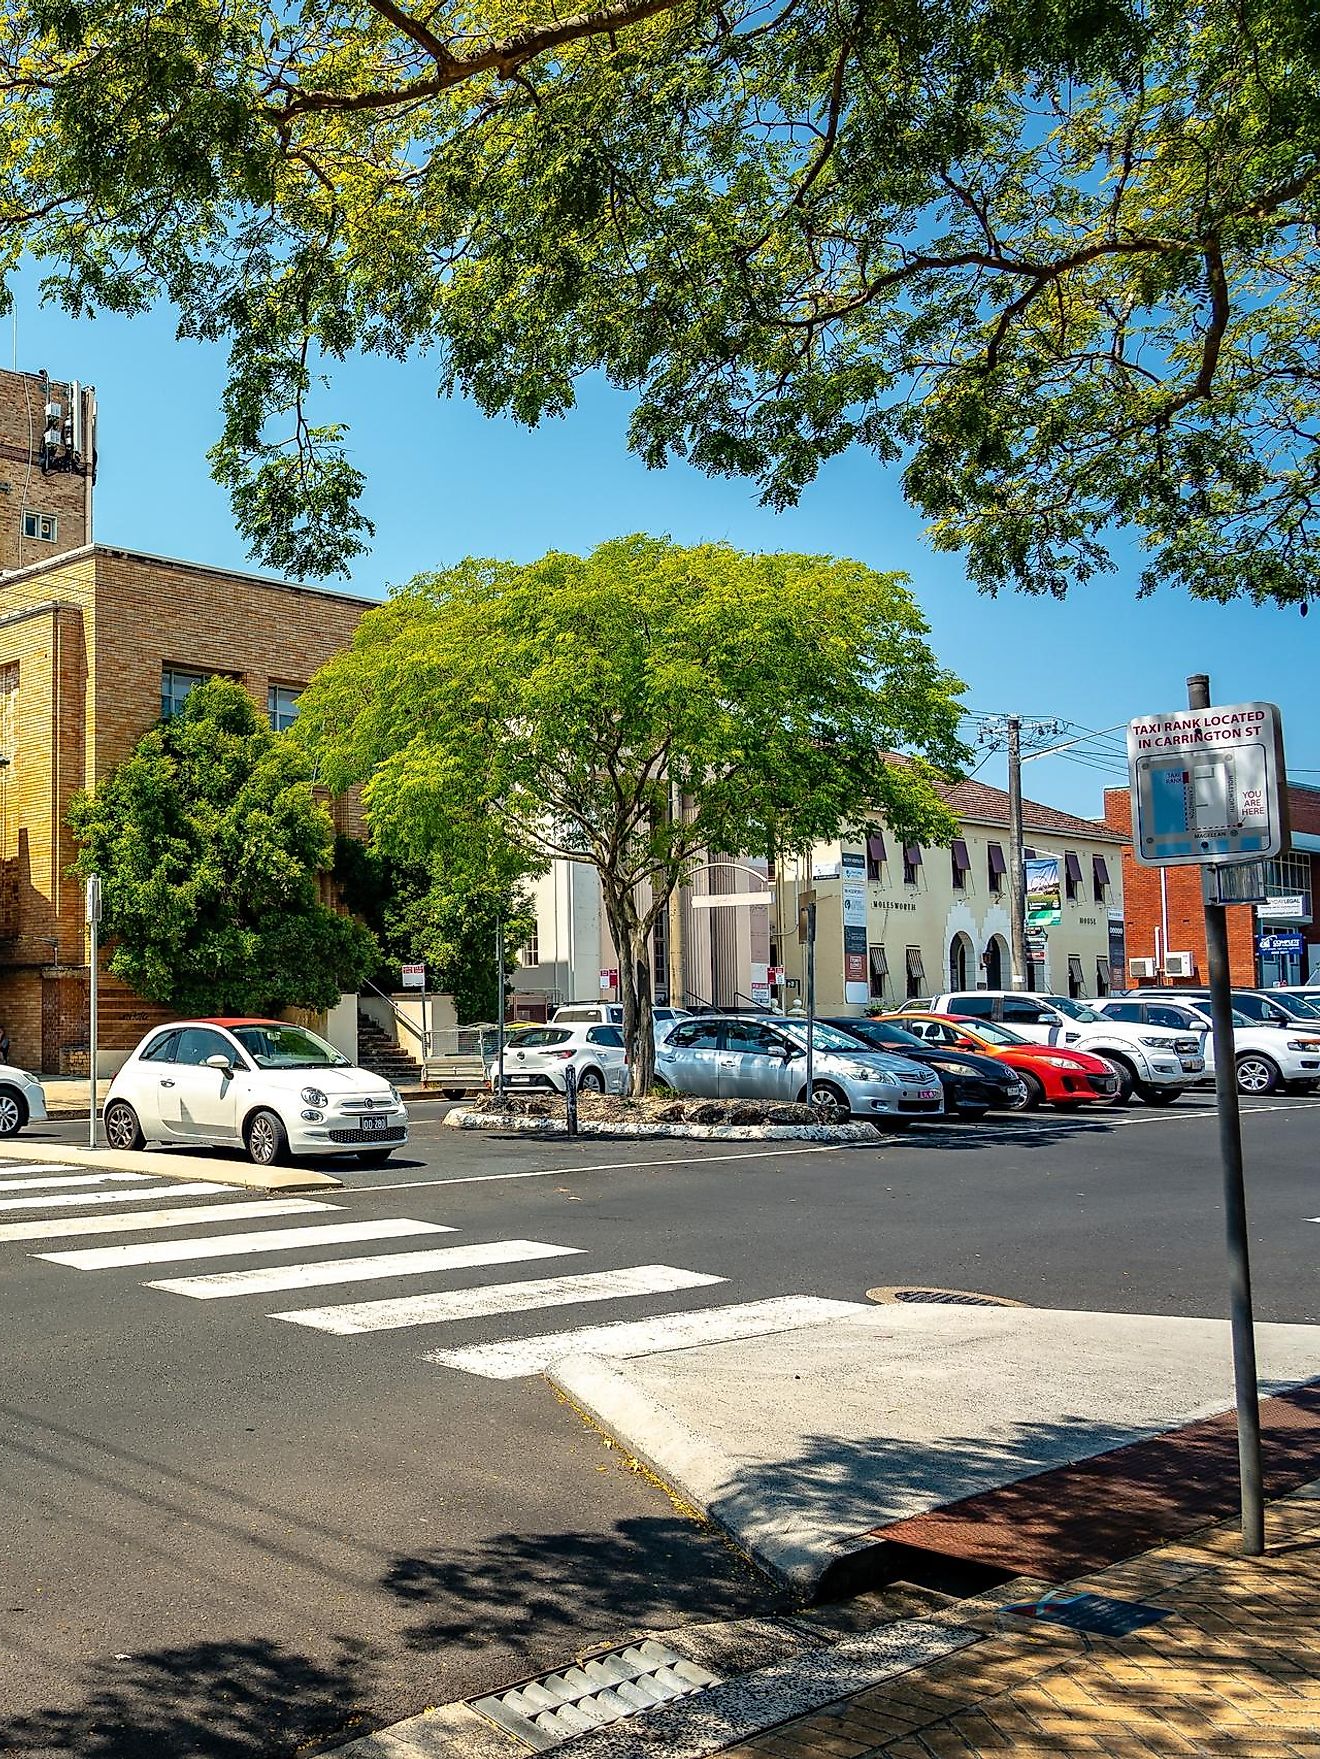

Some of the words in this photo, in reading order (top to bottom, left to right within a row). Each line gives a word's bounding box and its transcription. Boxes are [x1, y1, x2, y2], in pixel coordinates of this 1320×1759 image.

[1133, 723, 1161, 736] TAXI
[1164, 718, 1201, 732] RANK
[1204, 710, 1265, 727] LOCATED
[1138, 739, 1151, 749] IN
[1155, 727, 1242, 747] CARRINGTON
[1245, 725, 1262, 737] ST
[1242, 790, 1263, 799] YOU
[1244, 798, 1261, 807] ARE
[1241, 807, 1265, 816] HERE
[872, 901, 917, 911] MOLESWORTH
